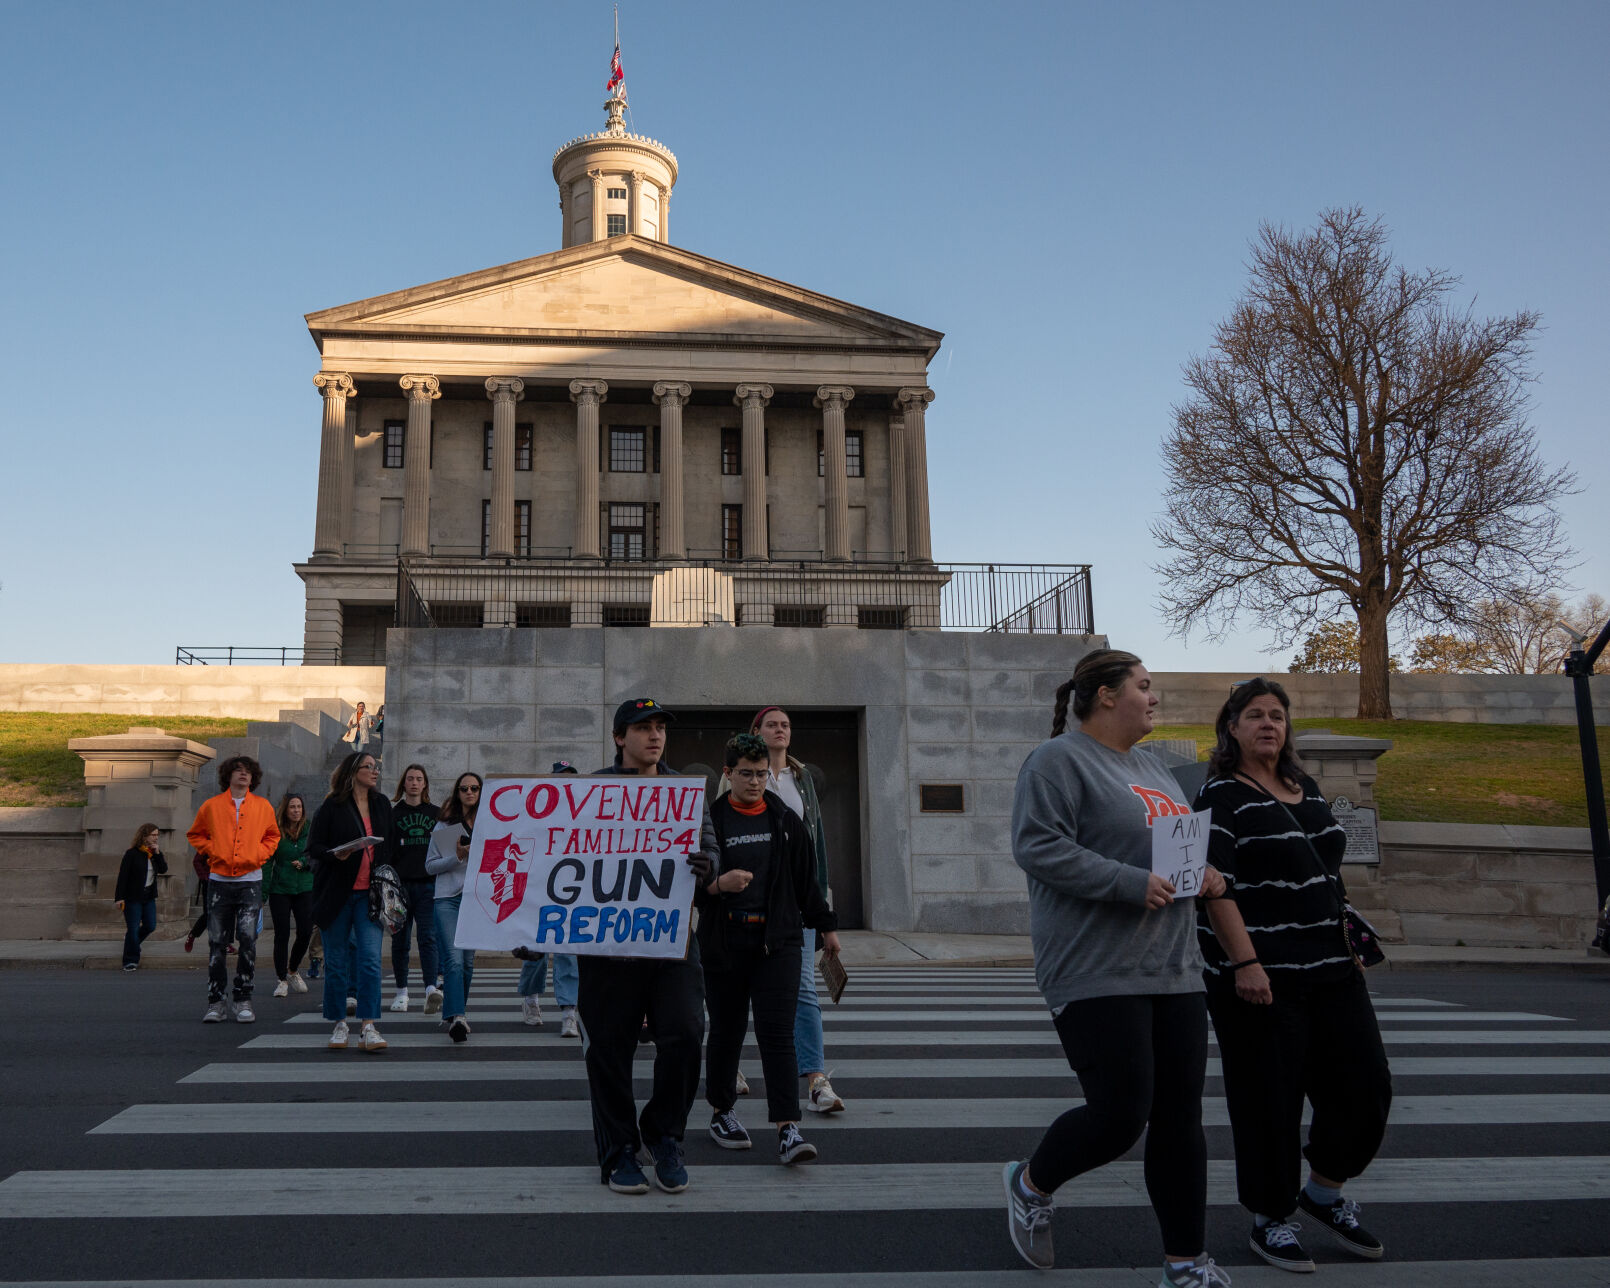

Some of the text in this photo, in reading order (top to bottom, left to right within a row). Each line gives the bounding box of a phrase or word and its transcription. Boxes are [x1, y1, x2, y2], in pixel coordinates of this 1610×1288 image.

[489, 784, 704, 823] COVENANT
[397, 813, 435, 831] CELTICS
[1172, 817, 1201, 839] AM
[1179, 843, 1194, 865] I
[546, 858, 675, 905] GUN
[536, 905, 680, 944] REFORM
